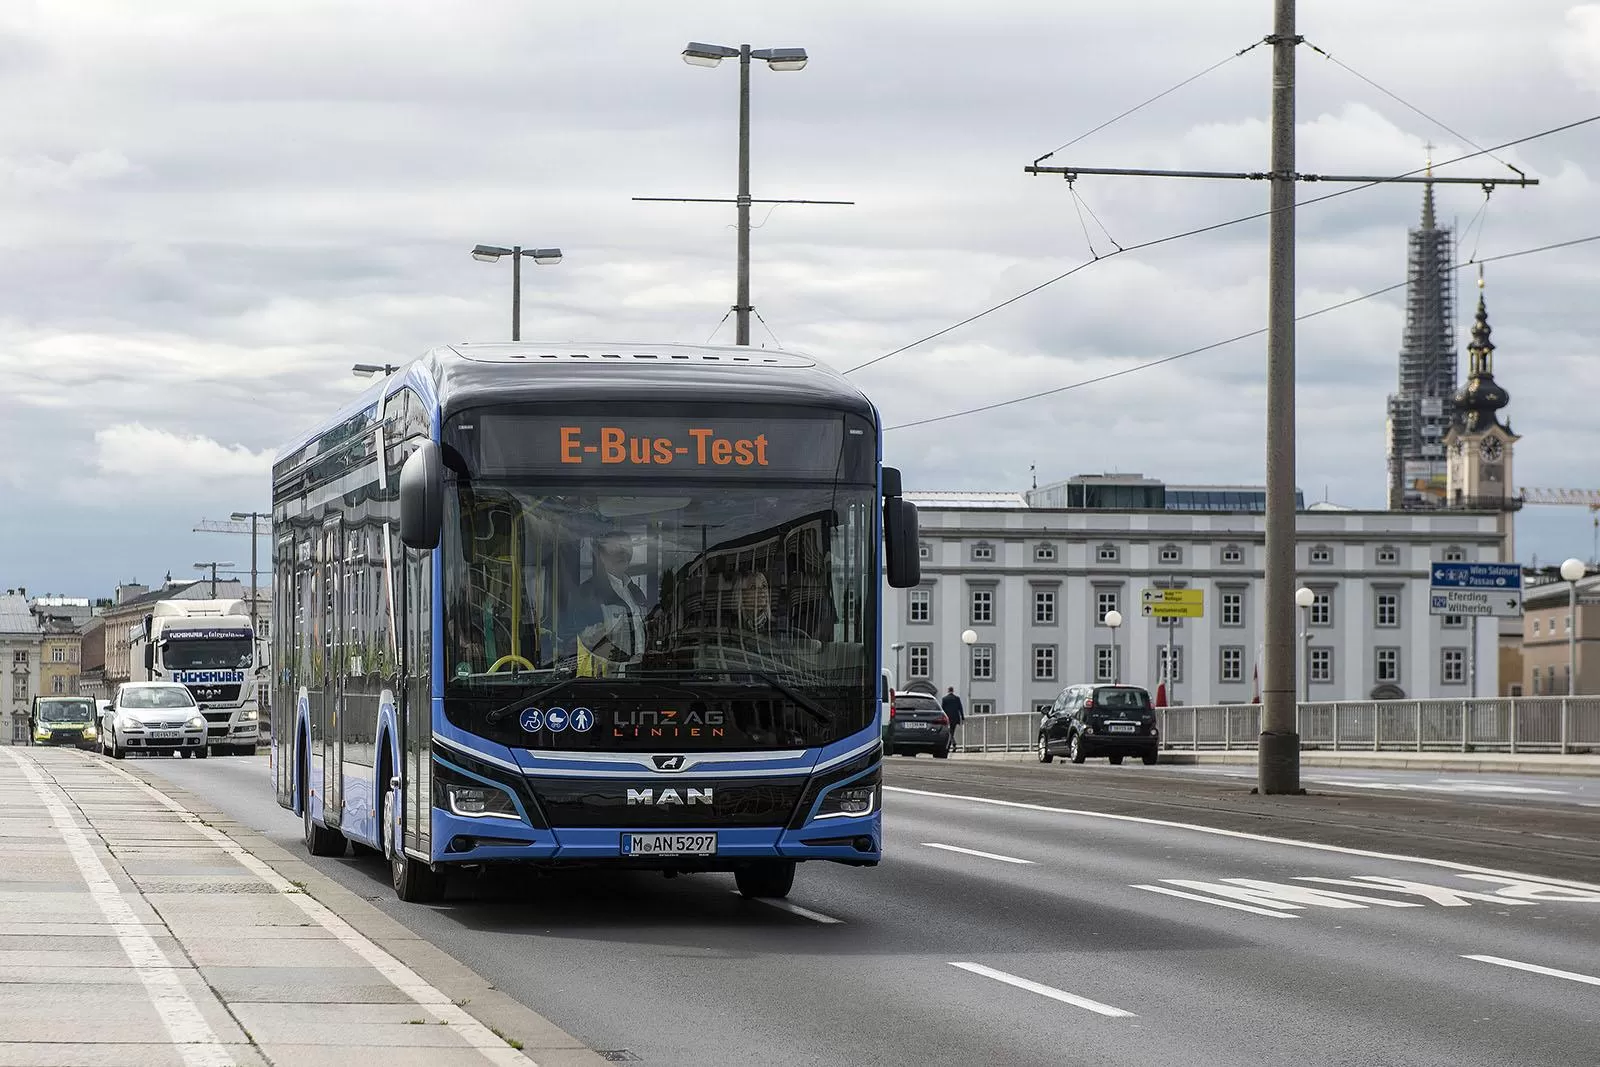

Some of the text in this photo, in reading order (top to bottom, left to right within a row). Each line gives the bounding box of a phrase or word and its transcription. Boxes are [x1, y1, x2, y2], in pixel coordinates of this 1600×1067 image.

[559, 426, 769, 466] E-Bus-Test
[1470, 566, 1518, 577] Wien Salzburg
[1469, 577, 1494, 585] Passau
[1448, 592, 1487, 603] Eferding
[173, 671, 245, 683] FUCHSHUBER
[196, 689, 222, 697] MAN
[683, 711, 723, 725] AG
[613, 728, 724, 737] LINIEN
[626, 787, 714, 805] MAN
[676, 836, 714, 851] 5297
